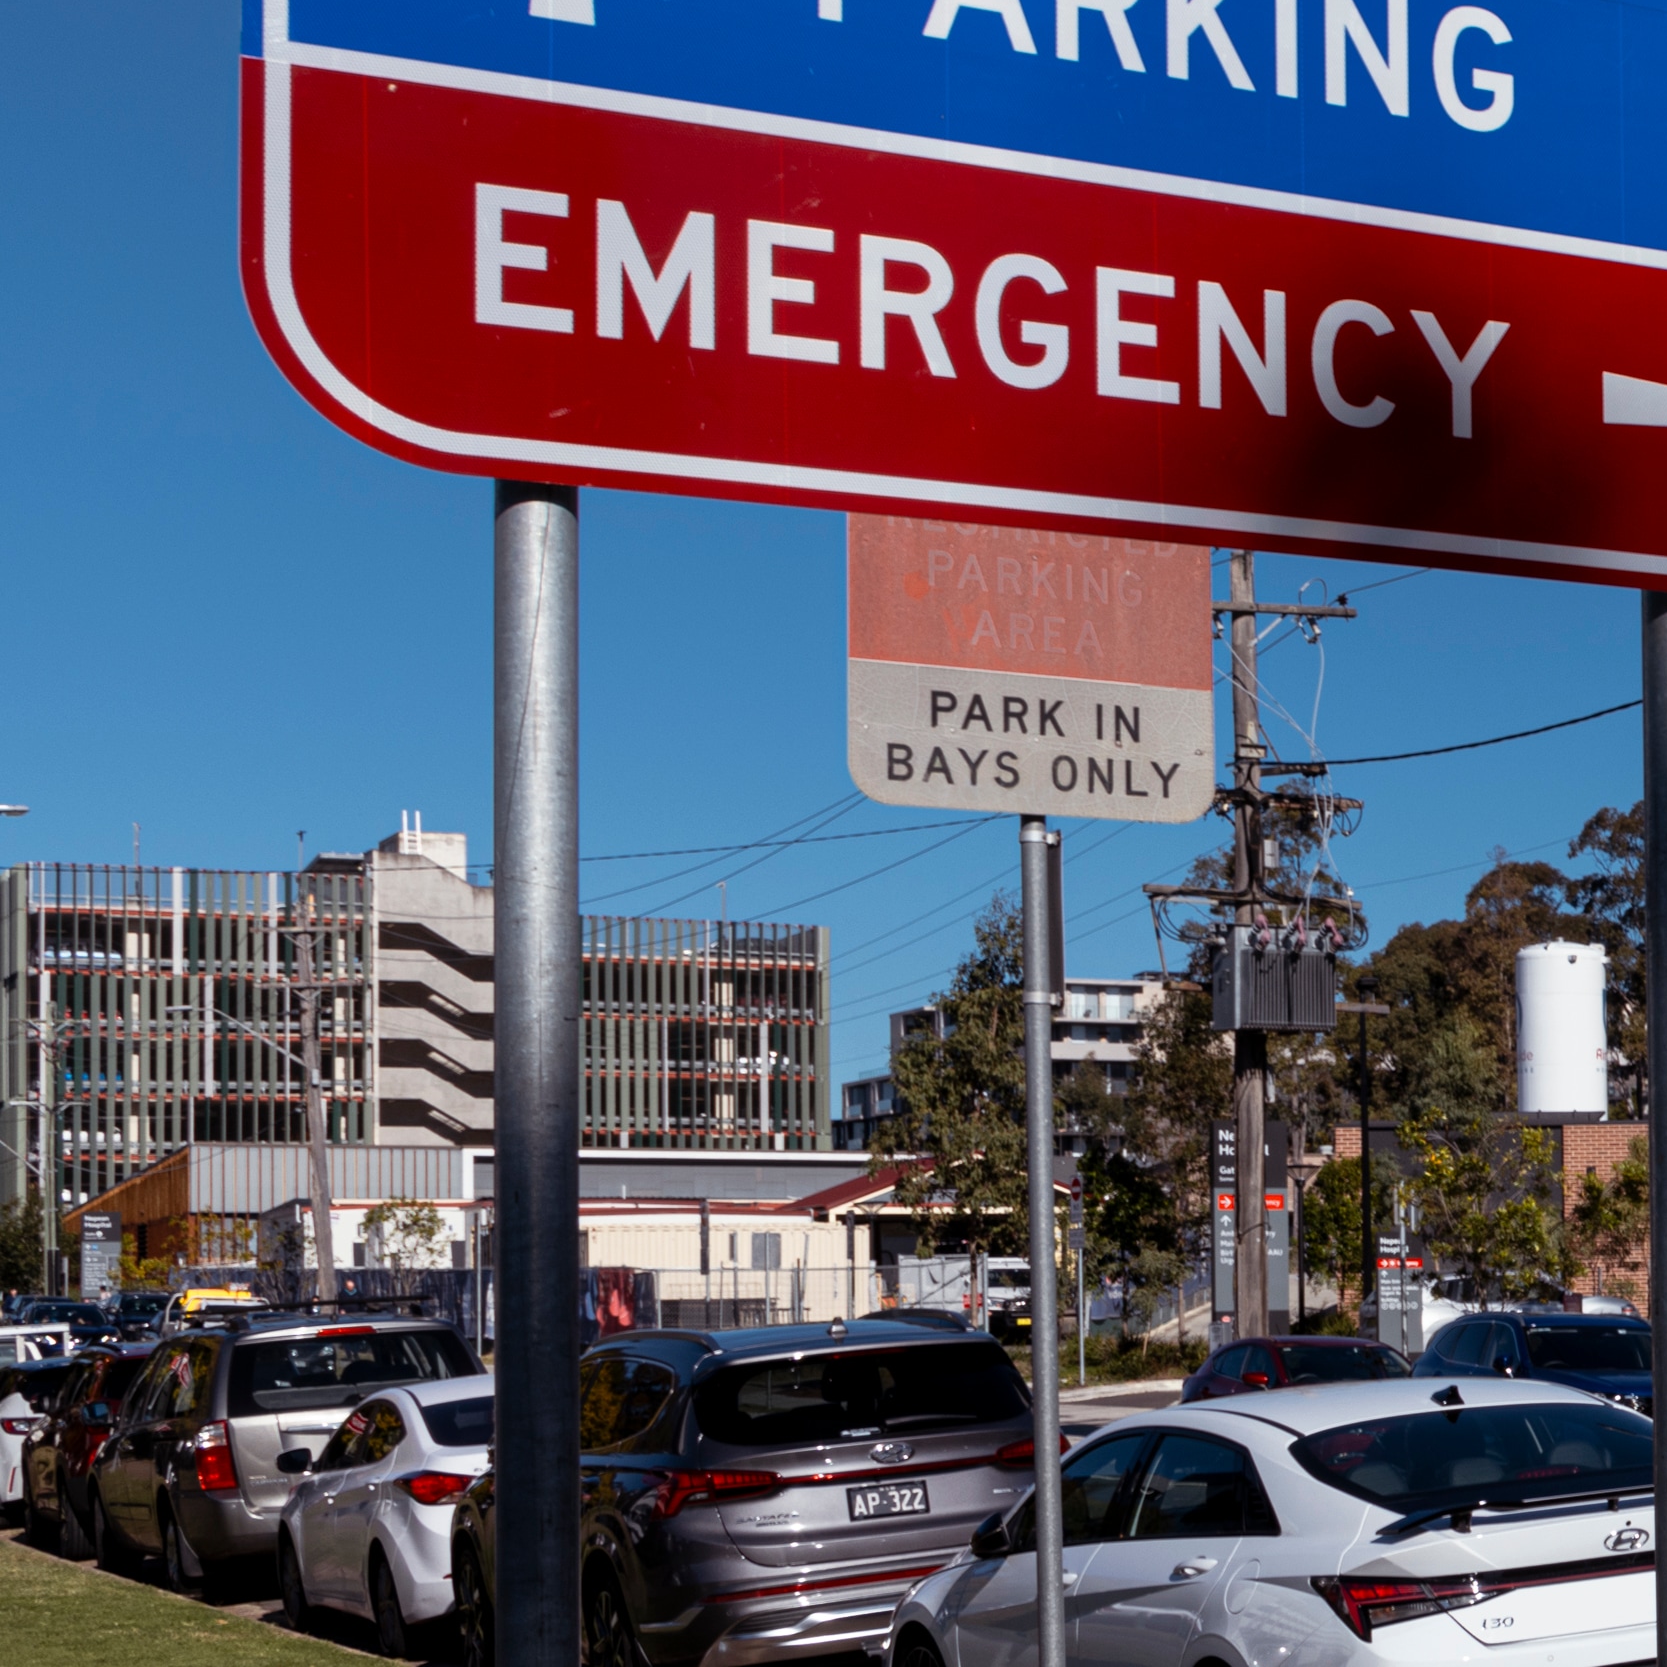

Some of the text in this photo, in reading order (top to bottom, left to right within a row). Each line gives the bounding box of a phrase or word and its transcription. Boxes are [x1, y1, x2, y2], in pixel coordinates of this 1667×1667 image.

[473, 182, 1511, 439] EMERGENCY
[927, 549, 1143, 608] PARKING
[970, 609, 1104, 655] AREA
[930, 689, 1141, 744] PARK IN
[886, 742, 1181, 800] BAYS ONLY
